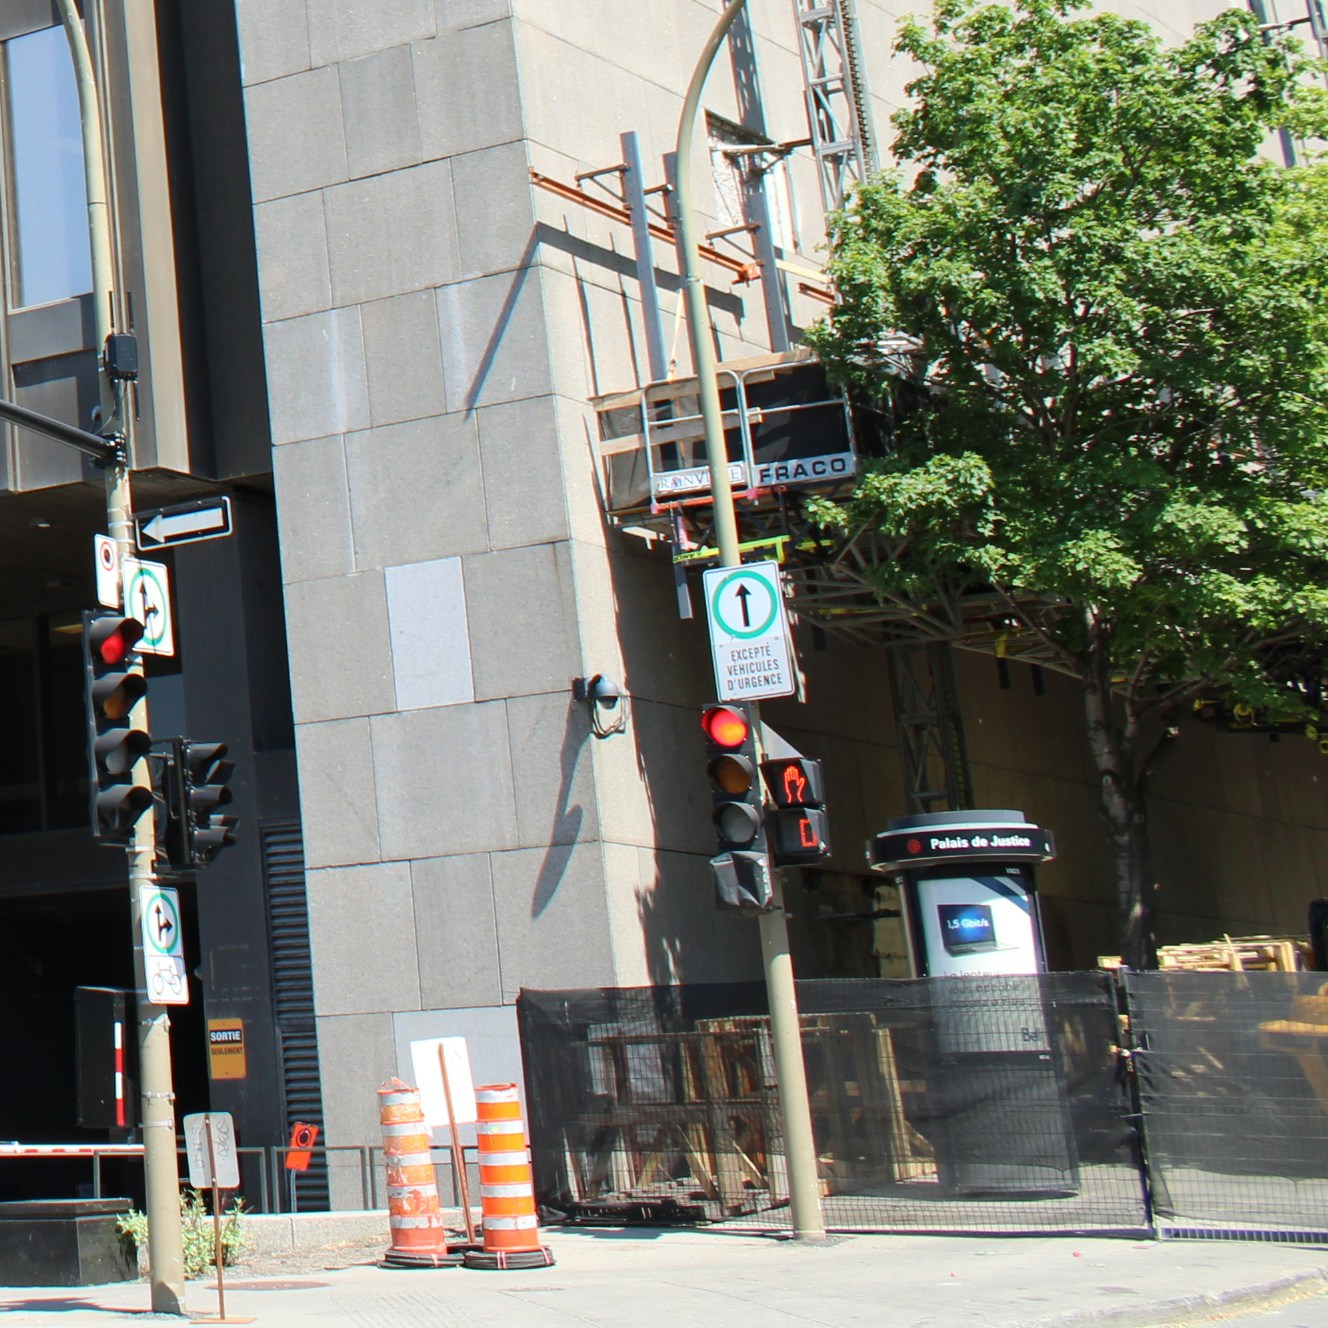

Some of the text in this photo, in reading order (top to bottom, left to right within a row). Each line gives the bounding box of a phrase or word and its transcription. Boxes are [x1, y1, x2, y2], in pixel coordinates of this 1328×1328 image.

[760, 457, 846, 483] FRACO
[731, 641, 771, 661] EXCEPTÉ
[726, 658, 780, 677] VÉHICULES
[727, 673, 783, 691] D'URGENCE
[930, 834, 1031, 850] Palais de Justice
[210, 1030, 241, 1042] SORTIE
